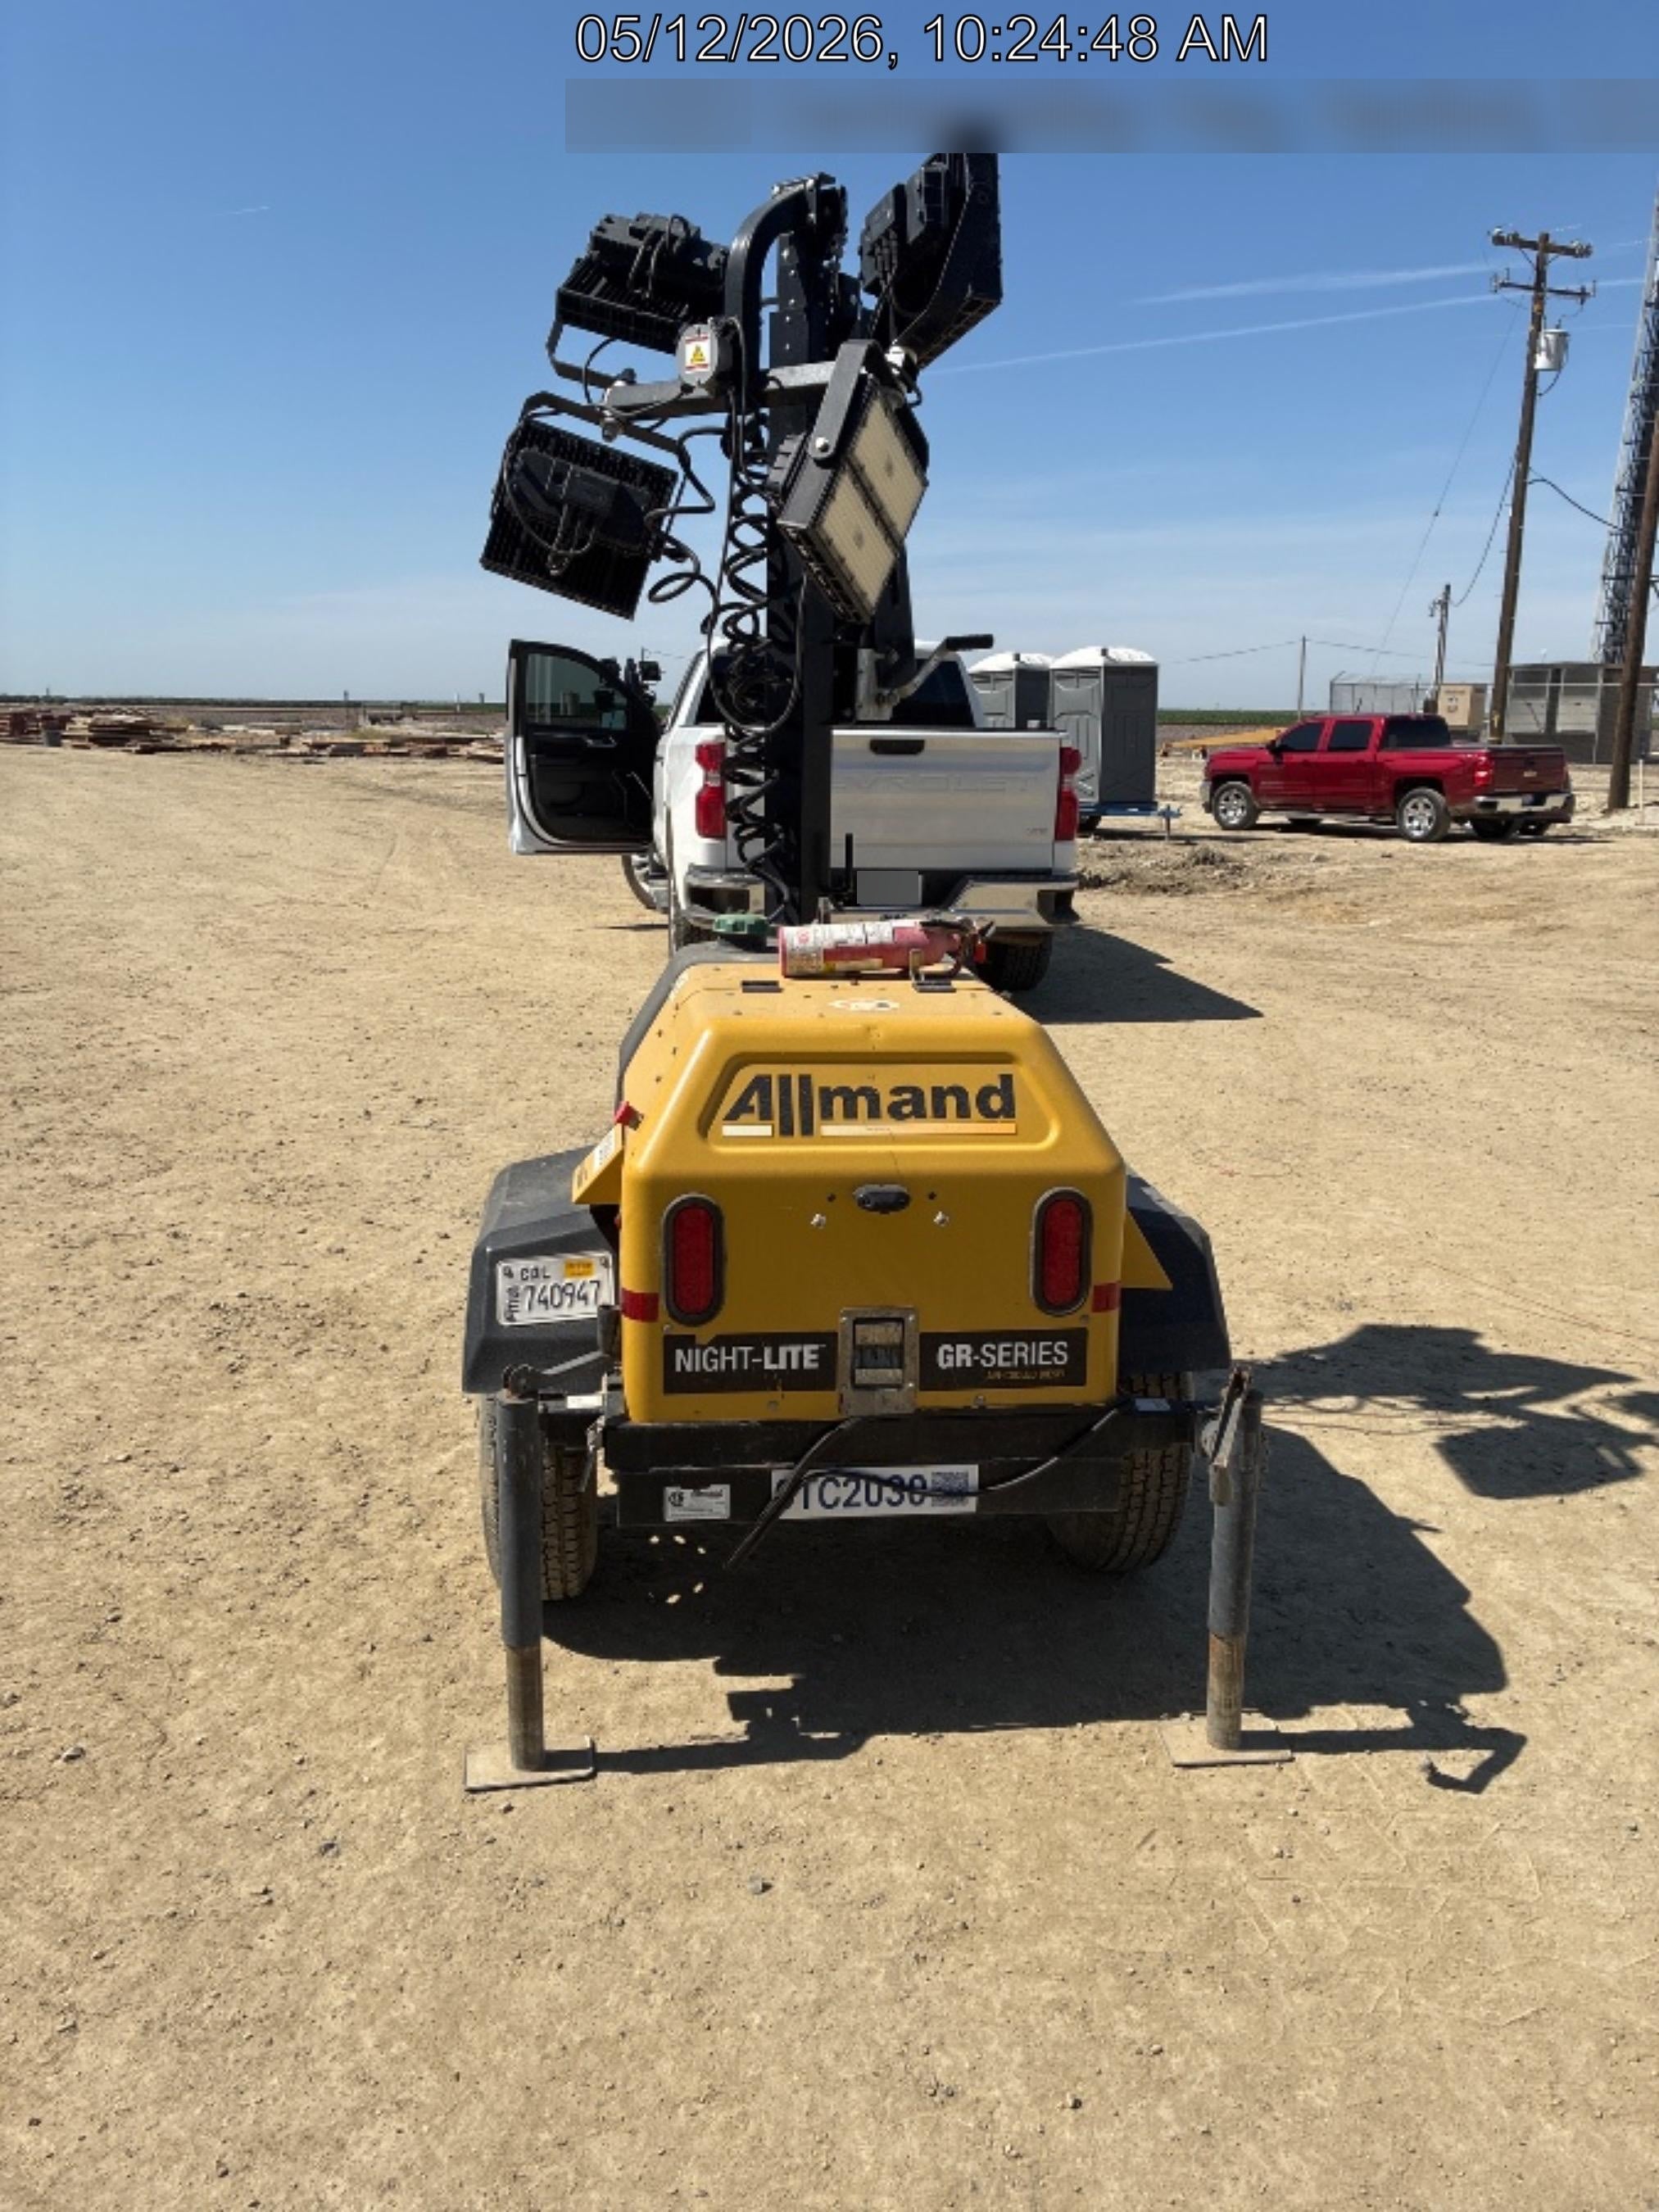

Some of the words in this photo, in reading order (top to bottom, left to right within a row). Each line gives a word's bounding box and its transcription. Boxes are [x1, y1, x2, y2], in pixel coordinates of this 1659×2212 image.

[722, 1074, 1016, 1136] Allmand
[524, 1280, 601, 1312] 740947
[675, 1344, 820, 1372] NIGHT-LITE
[937, 1341, 1068, 1369] GR-SERIES
